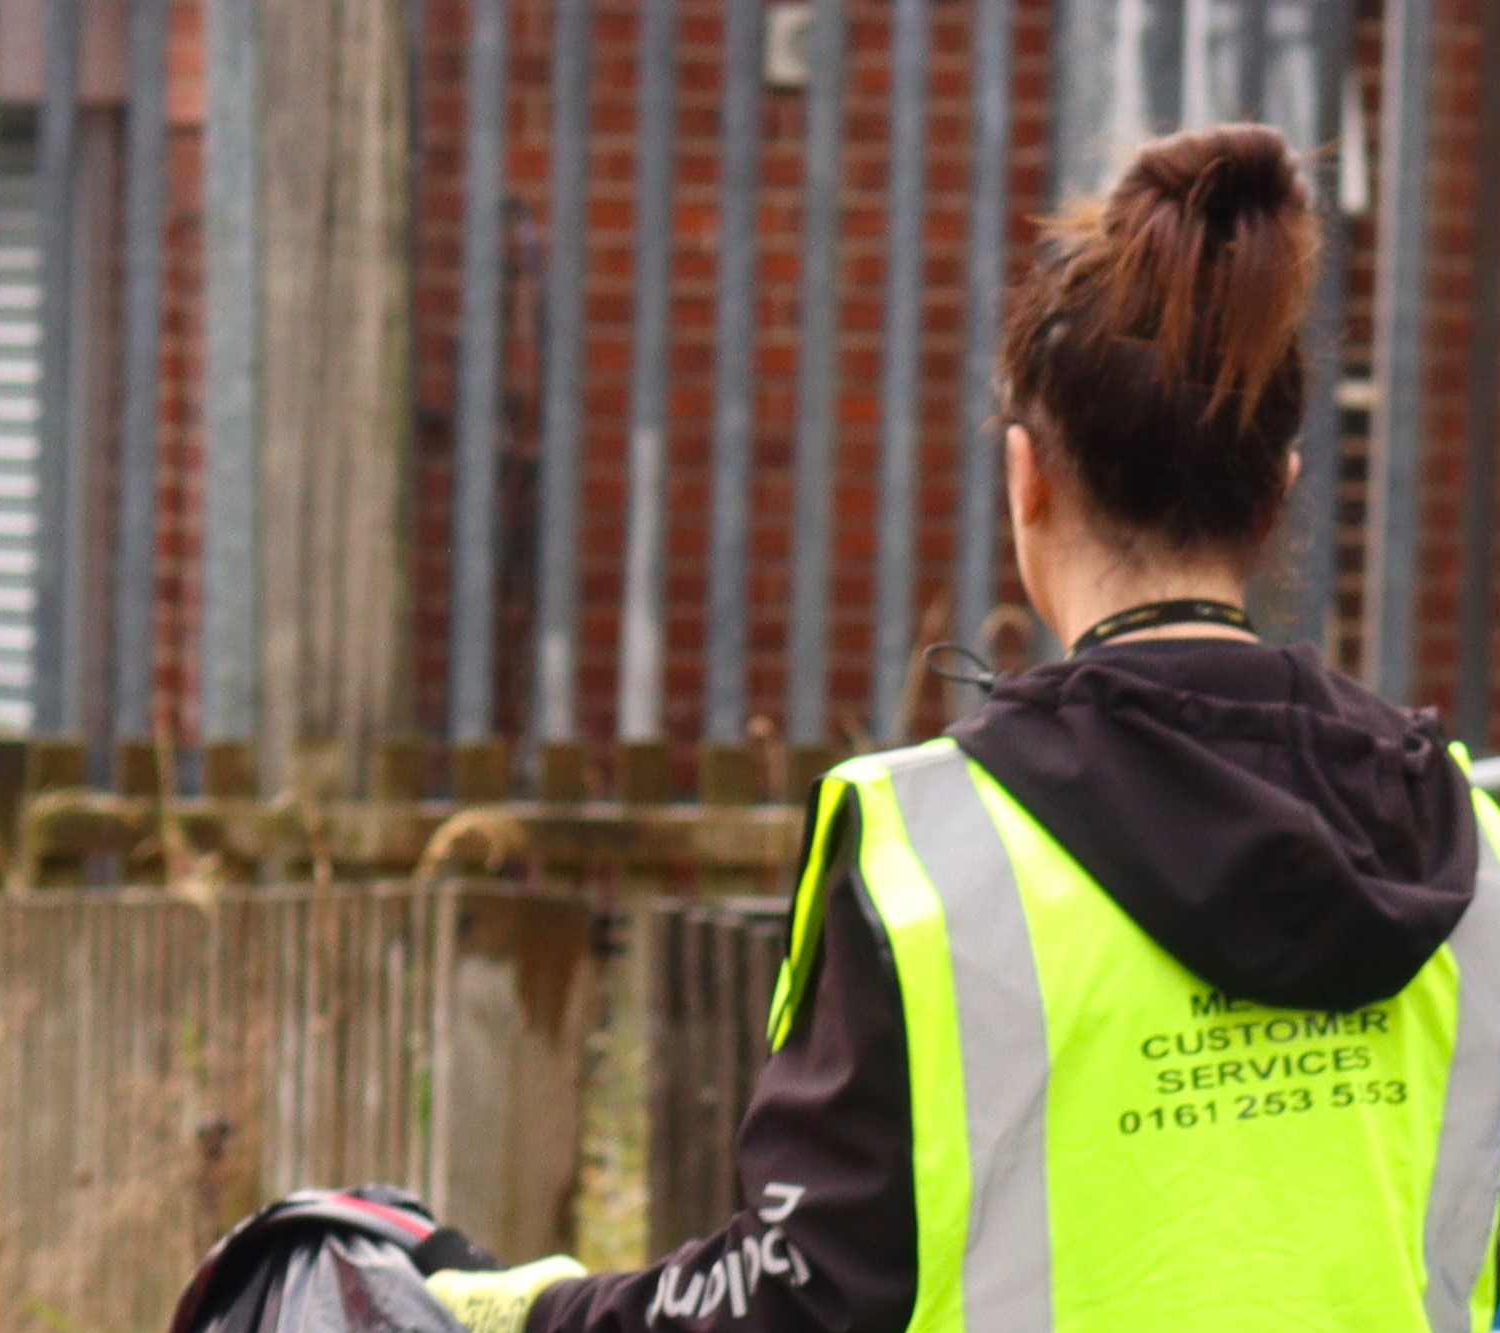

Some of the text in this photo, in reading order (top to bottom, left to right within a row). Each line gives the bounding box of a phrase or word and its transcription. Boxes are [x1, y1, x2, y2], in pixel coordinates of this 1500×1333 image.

[1141, 1009, 1389, 1060] CUSTOMER
[1157, 1046, 1371, 1095] SERVICES
[1118, 1080, 1408, 1135] 0161 253 553
